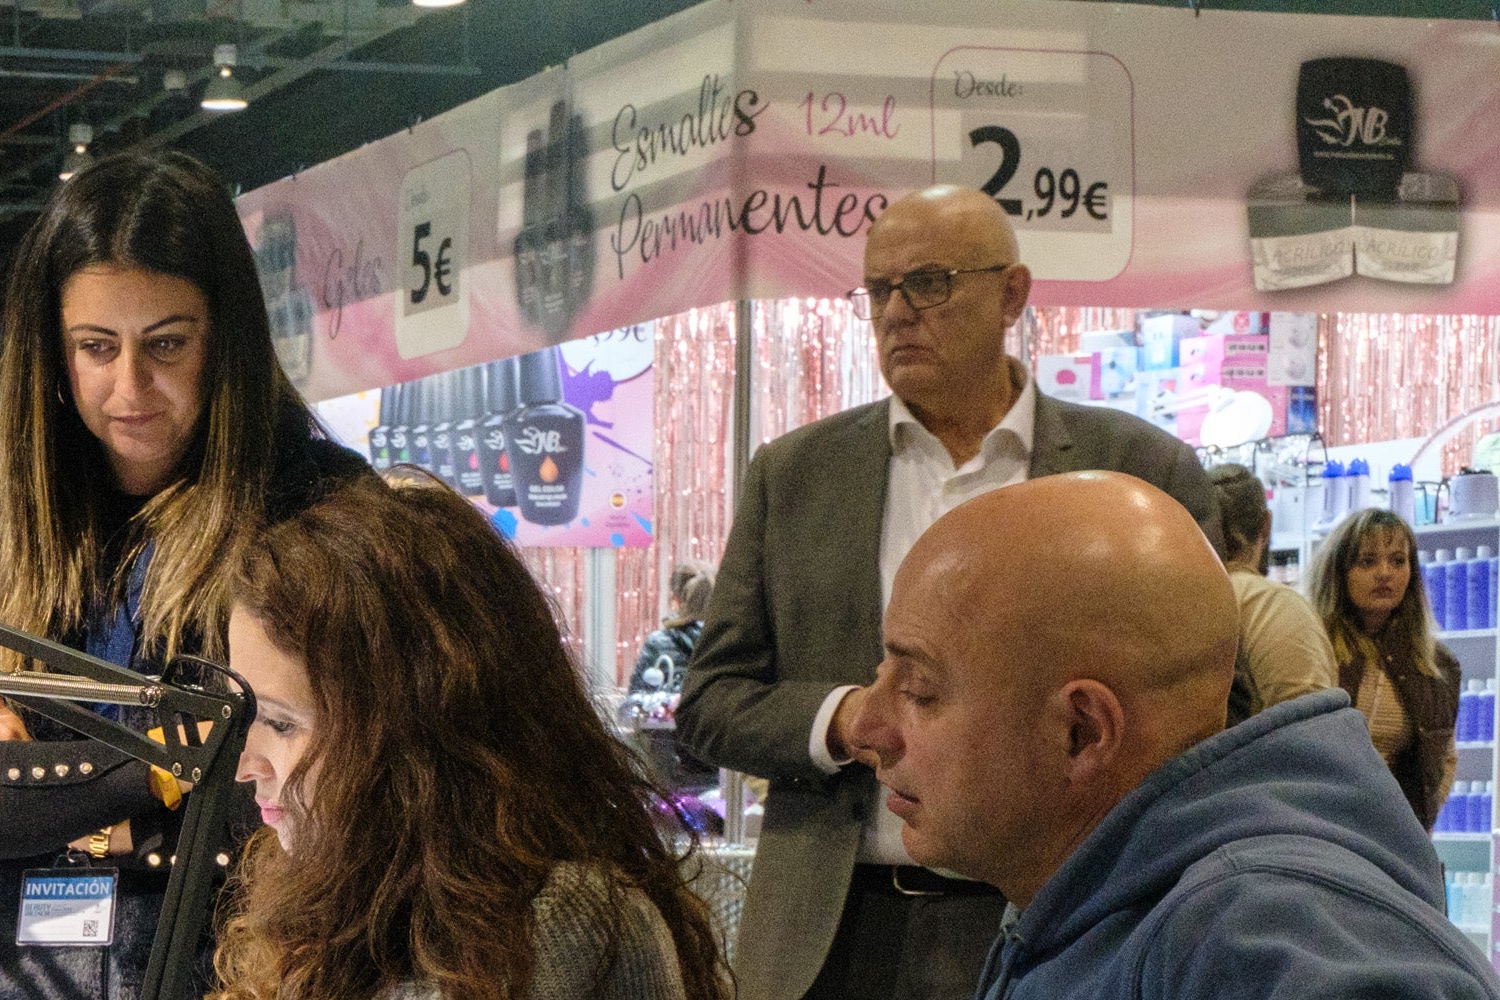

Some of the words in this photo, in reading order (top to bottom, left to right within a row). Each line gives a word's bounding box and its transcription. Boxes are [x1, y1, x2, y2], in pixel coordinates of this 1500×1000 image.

[954, 70, 1024, 99] Desde:
[611, 74, 771, 192] Esmaltes
[798, 91, 901, 140] 12ml
[968, 124, 1109, 222] 2,99€
[410, 220, 452, 304] 5€
[26, 880, 110, 896] INVITACIÓN
